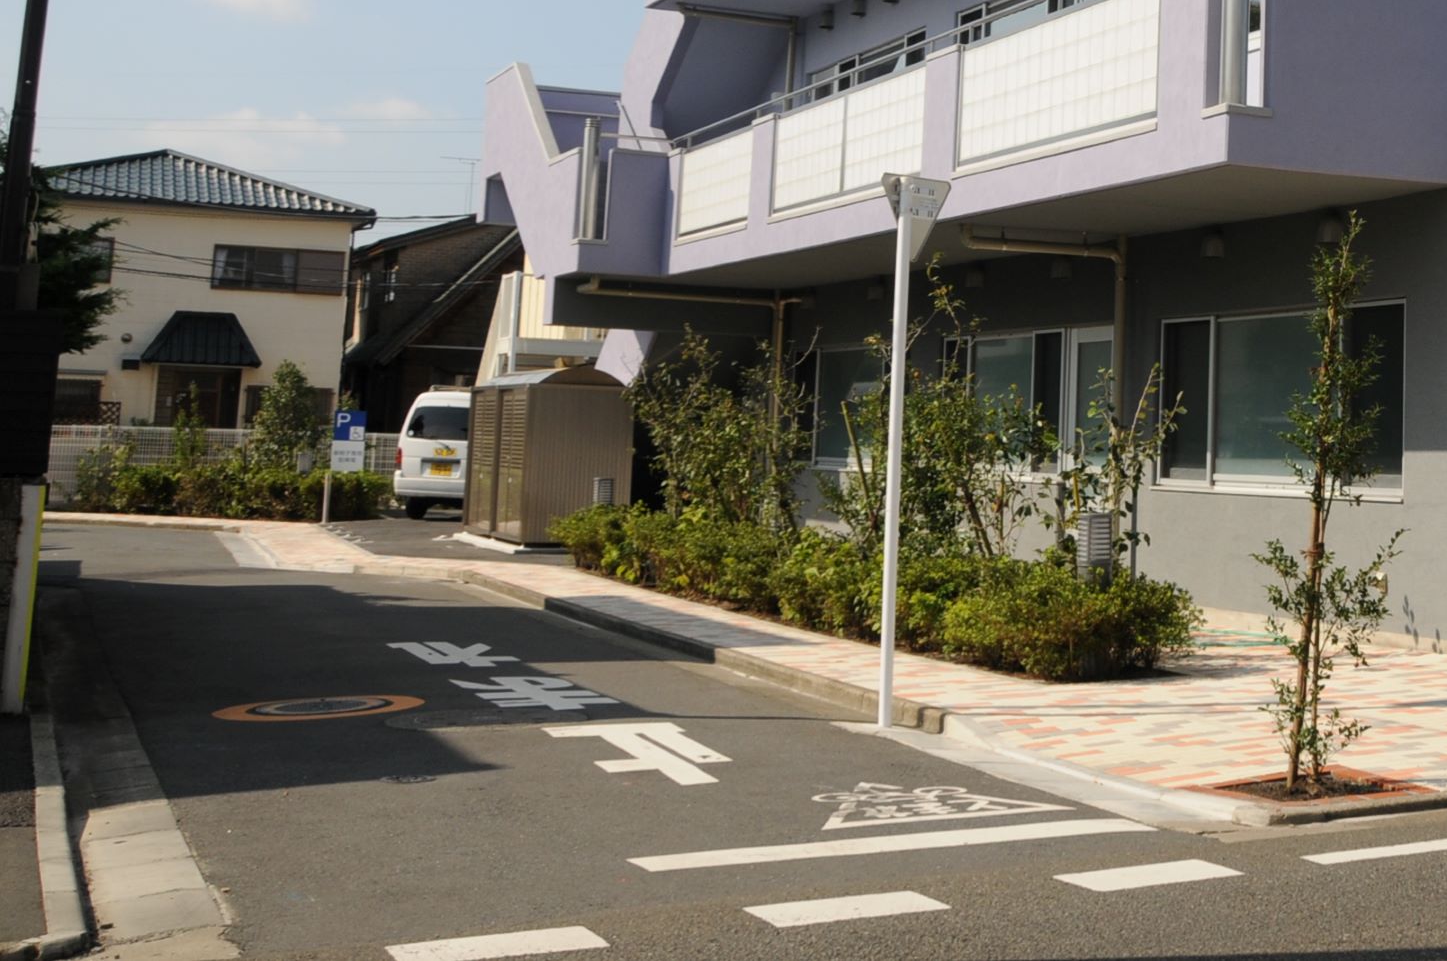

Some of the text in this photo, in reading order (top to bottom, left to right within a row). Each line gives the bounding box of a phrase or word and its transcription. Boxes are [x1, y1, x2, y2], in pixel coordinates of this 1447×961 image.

[336, 413, 351, 428] P
[386, 641, 734, 786] 止まれ
